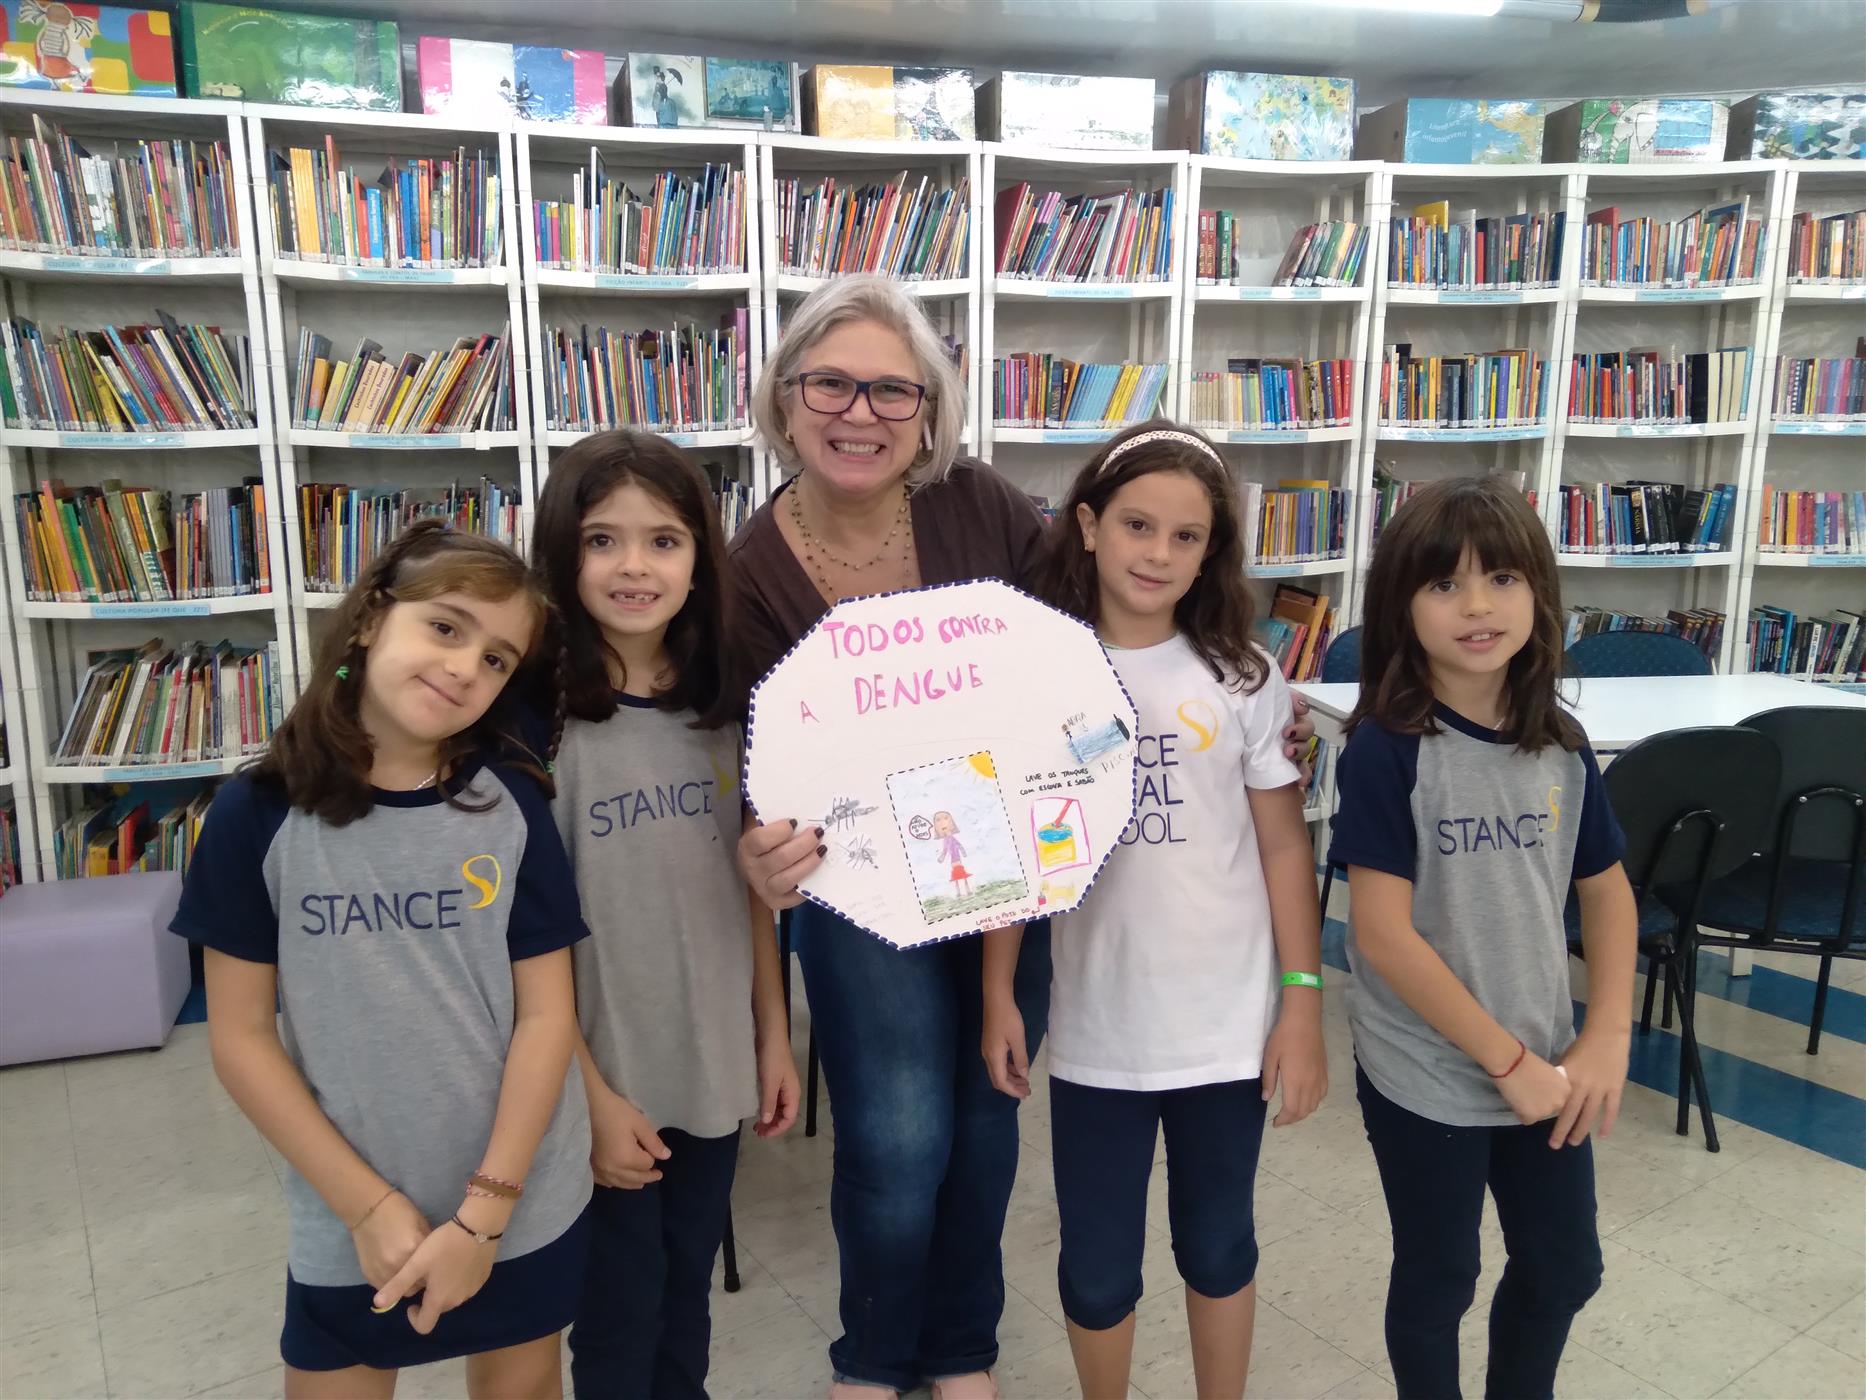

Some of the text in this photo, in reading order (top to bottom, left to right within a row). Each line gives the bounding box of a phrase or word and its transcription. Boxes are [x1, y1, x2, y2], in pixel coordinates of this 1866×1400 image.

[822, 613, 1008, 659] TODOS CONTRA
[800, 663, 984, 724] A DENGUE
[1025, 767, 1089, 783] LAVE OS TANQUES
[589, 780, 713, 838] STANCE
[1438, 813, 1548, 856] STANCE
[300, 888, 463, 936] STANCE
